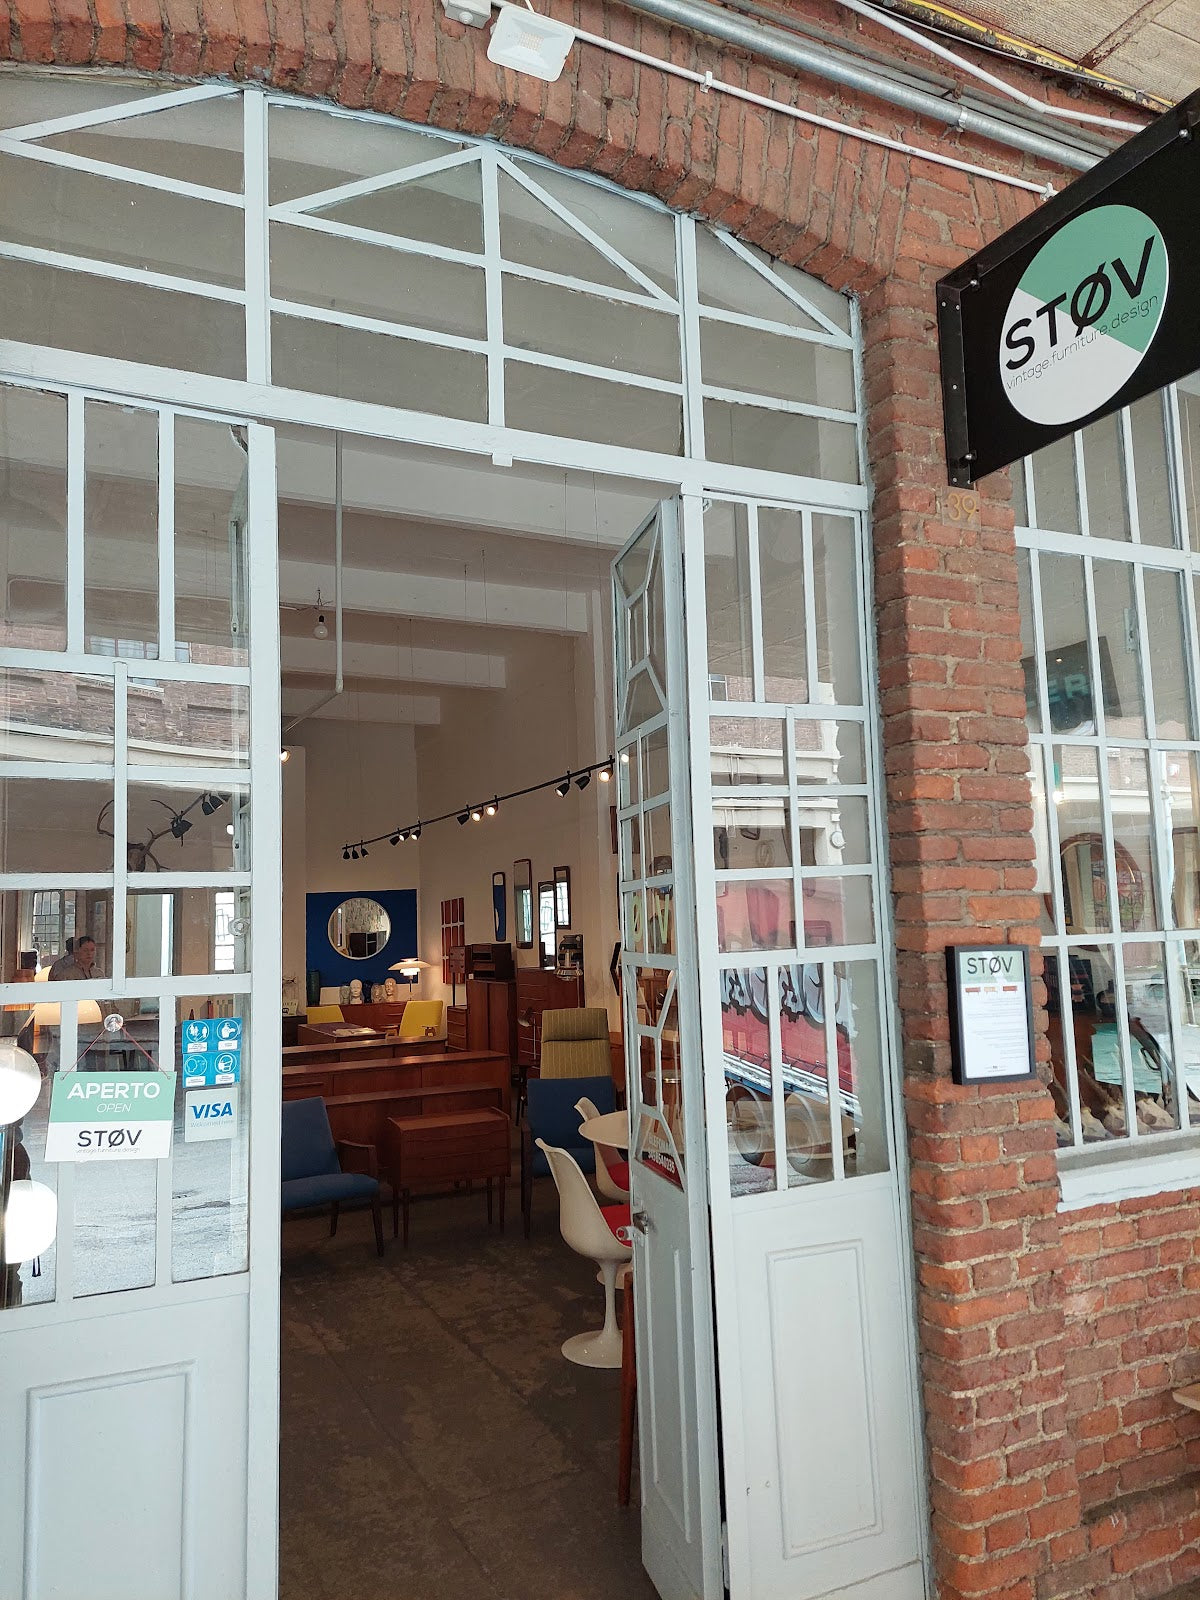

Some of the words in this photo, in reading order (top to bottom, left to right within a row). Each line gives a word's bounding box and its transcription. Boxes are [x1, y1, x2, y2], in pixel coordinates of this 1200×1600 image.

[1005, 235, 1156, 370] STØV
[1006, 294, 1159, 390] vintage.furniture.design
[948, 493, 977, 522] 39
[967, 956, 1013, 975] STØV
[67, 1082, 161, 1099] APERTO
[96, 1103, 132, 1113] OPEN
[189, 1102, 233, 1119] VISA
[77, 1129, 143, 1148] STØV
